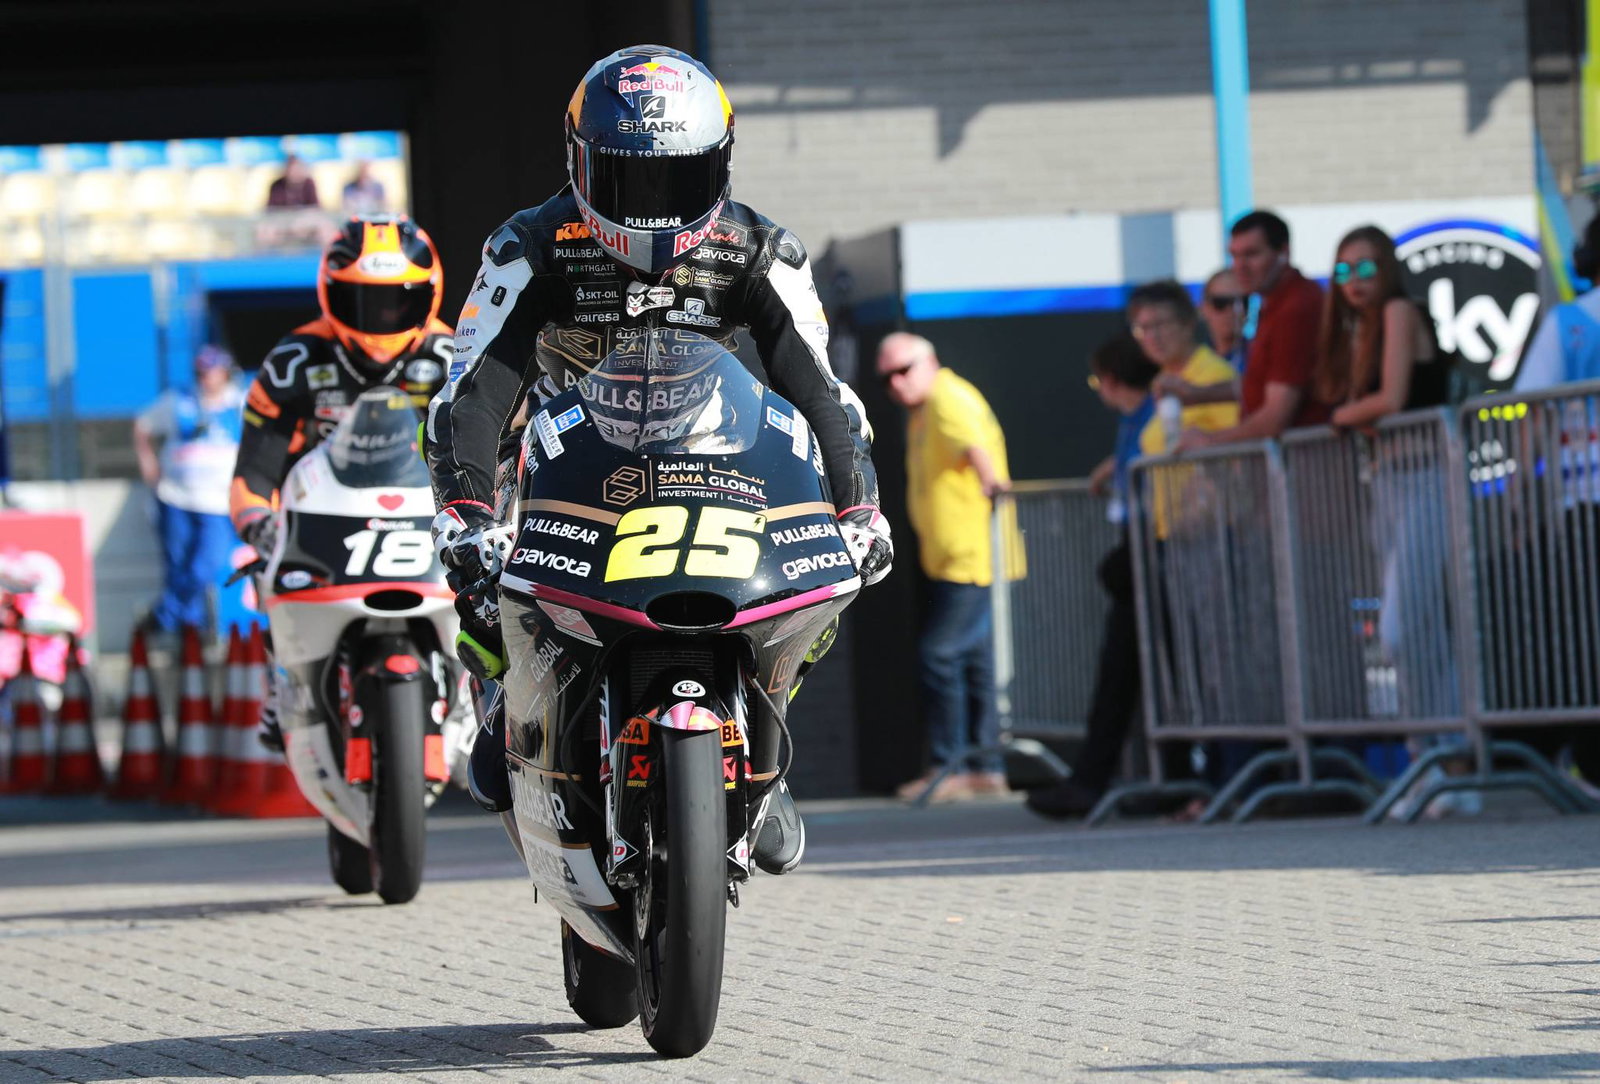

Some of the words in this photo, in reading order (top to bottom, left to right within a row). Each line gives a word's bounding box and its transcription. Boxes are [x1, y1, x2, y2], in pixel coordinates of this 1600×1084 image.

[618, 79, 651, 92] Red
[654, 79, 684, 93] Bull
[618, 120, 687, 133] SHARK
[600, 146, 631, 157] GIVES
[638, 149, 661, 158] YOU
[667, 147, 704, 157] WINGS
[625, 216, 682, 228] PULL&BEAR
[588, 214, 630, 257] Bull
[555, 248, 604, 258] PULL&BEAR
[567, 263, 616, 272] NORTHGATE
[586, 291, 619, 300] SKT-OIL
[574, 312, 620, 322] valresa
[668, 312, 720, 326] SHARK
[1427, 277, 1541, 382] ky
[658, 473, 705, 485] SAMA
[708, 475, 767, 500] GLOBAL
[658, 489, 719, 499] INVESTMENT
[523, 517, 599, 545] PULL&BEAR
[770, 523, 841, 547] PULL&BEAR
[604, 505, 768, 583] 25
[343, 529, 435, 577] 18
[511, 547, 592, 578] gaviota
[782, 550, 852, 581] gaviota
